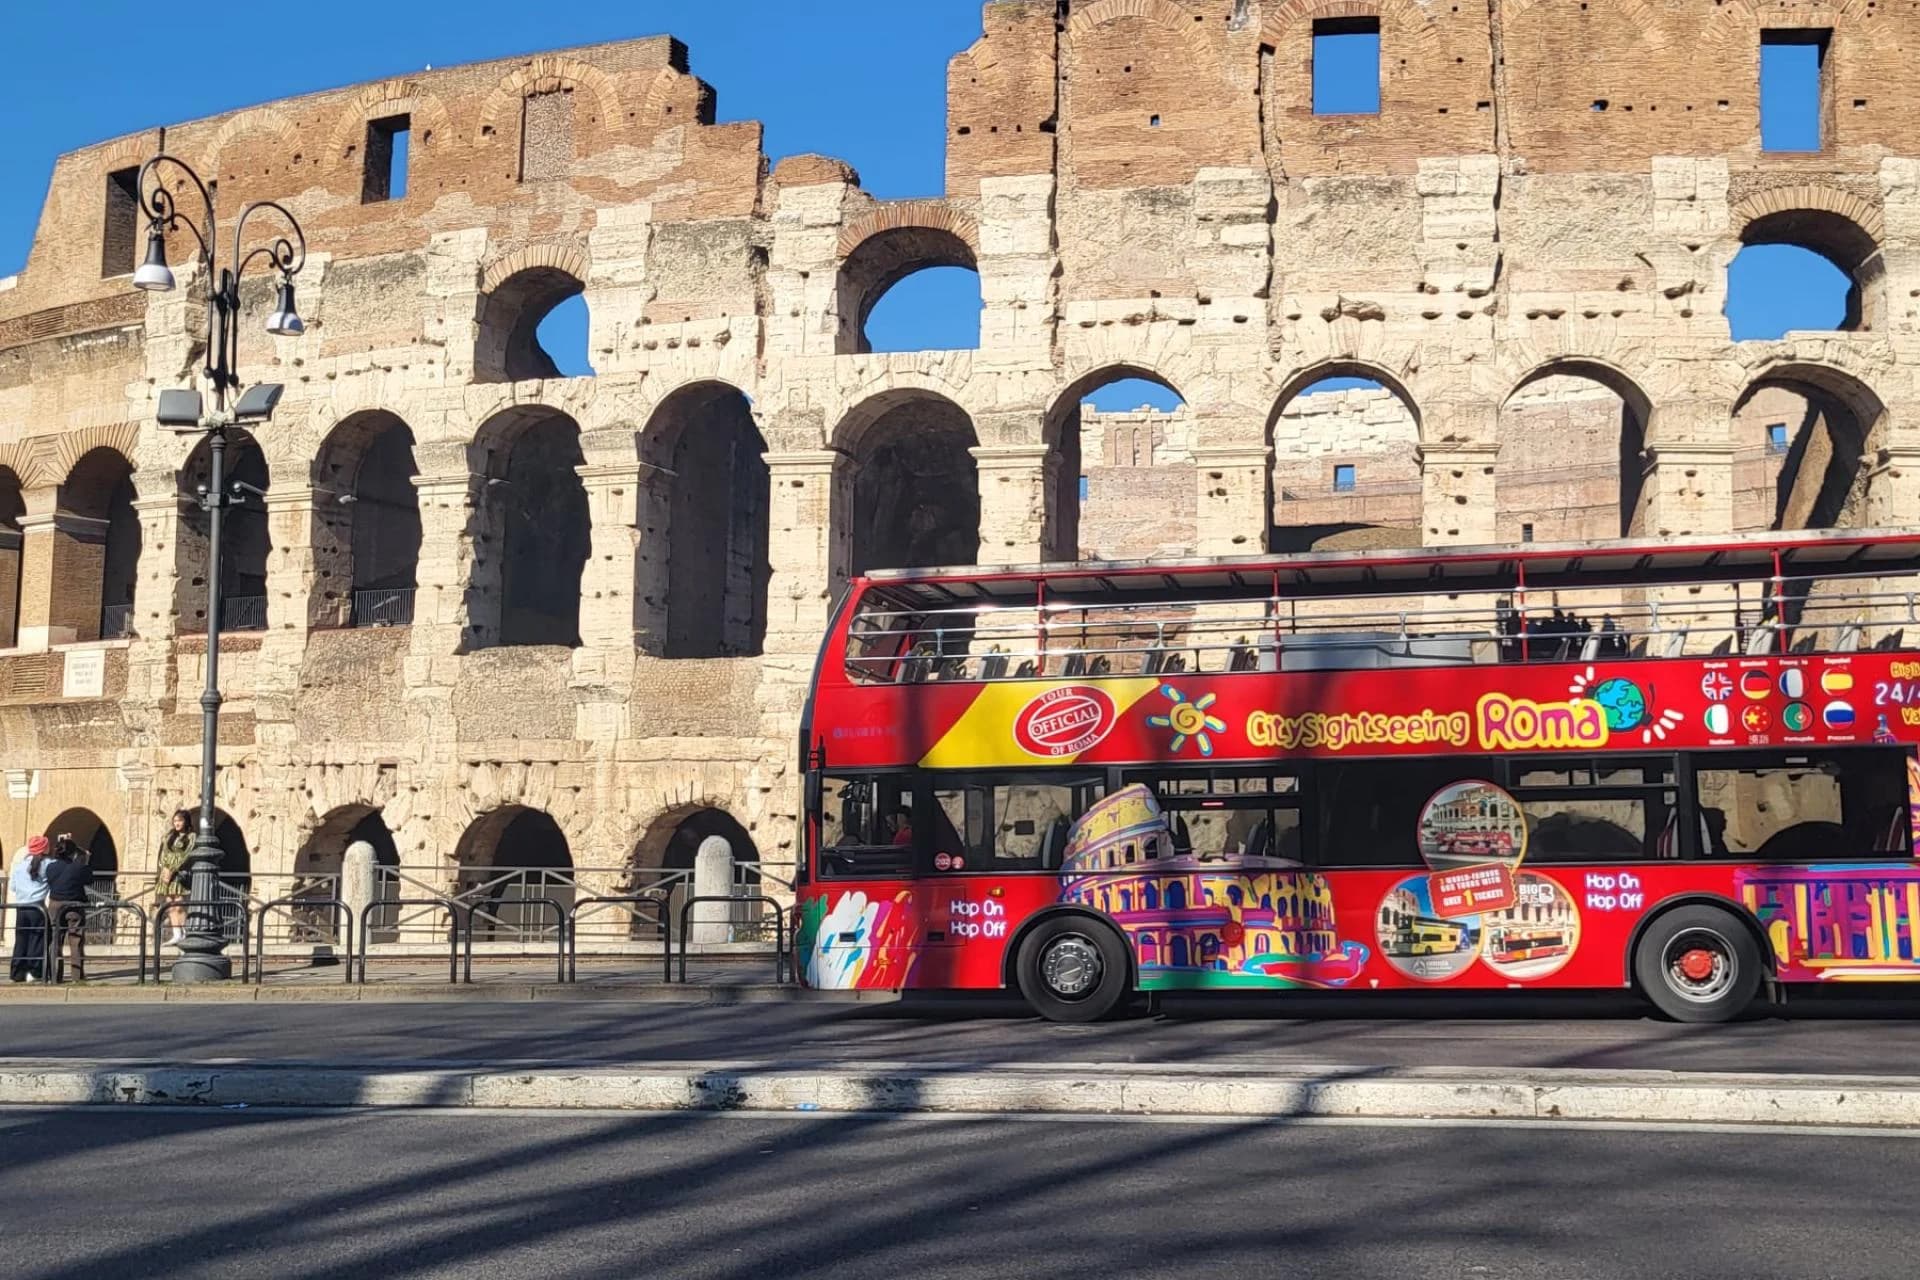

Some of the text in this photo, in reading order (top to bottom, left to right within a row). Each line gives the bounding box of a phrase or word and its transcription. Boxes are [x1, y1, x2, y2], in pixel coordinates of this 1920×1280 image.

[1041, 688, 1073, 705] TOUR
[1875, 682, 1920, 705] 24/
[1031, 706, 1097, 736] OFFICIAL
[1247, 692, 1609, 750] CitySightseeing Roma
[1051, 733, 1099, 755] OF ROMA
[1518, 884, 1537, 894] BIG
[1586, 872, 1640, 890] Hop On
[1463, 889, 1473, 906] 1
[1587, 893, 1644, 910] Hop Off
[951, 899, 1004, 917] Hop On
[951, 920, 1007, 938] Hop Off
